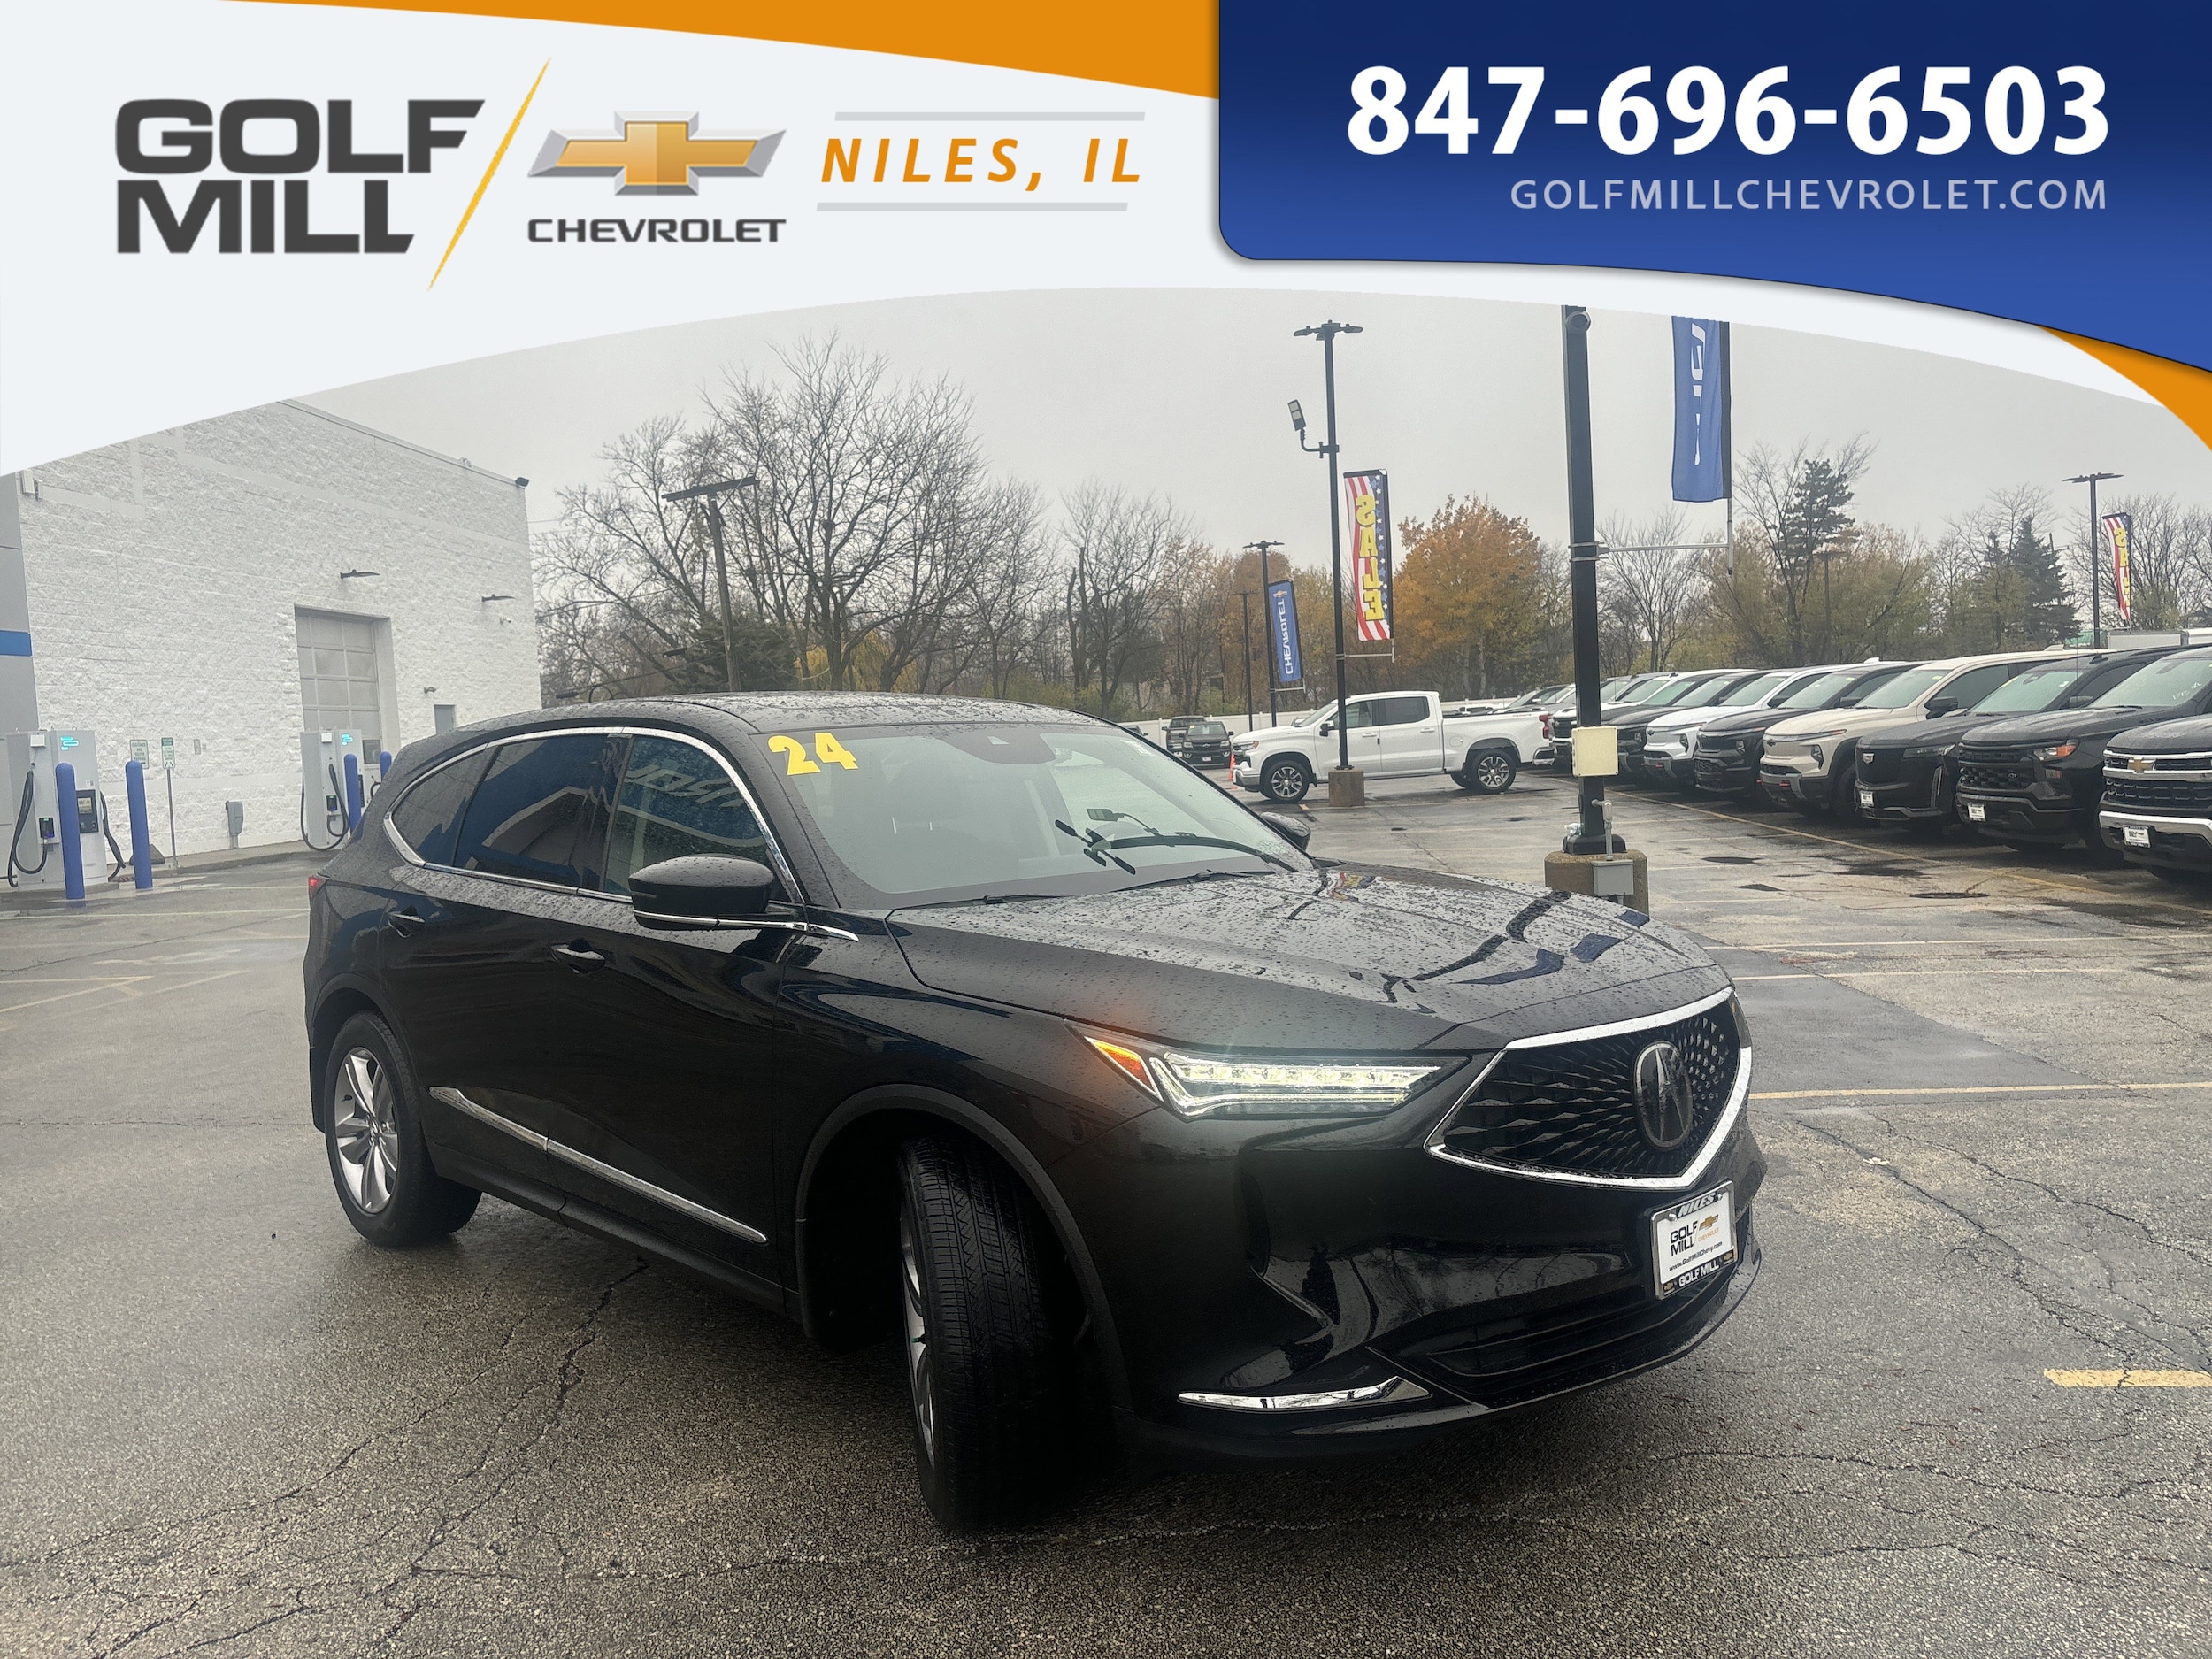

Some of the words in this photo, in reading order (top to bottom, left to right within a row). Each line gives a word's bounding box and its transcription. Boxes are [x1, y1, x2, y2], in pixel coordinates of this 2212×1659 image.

[767, 732, 859, 776] 24
[1678, 1192, 1716, 1218] NILES
[1670, 1220, 1698, 1244] GOLF
[1669, 1241, 1723, 1272] www.GolfMillChevy.com
[1671, 1236, 1694, 1257] MILL
[1678, 1268, 1701, 1287] GOLF
[1701, 1260, 1719, 1277] MILL
